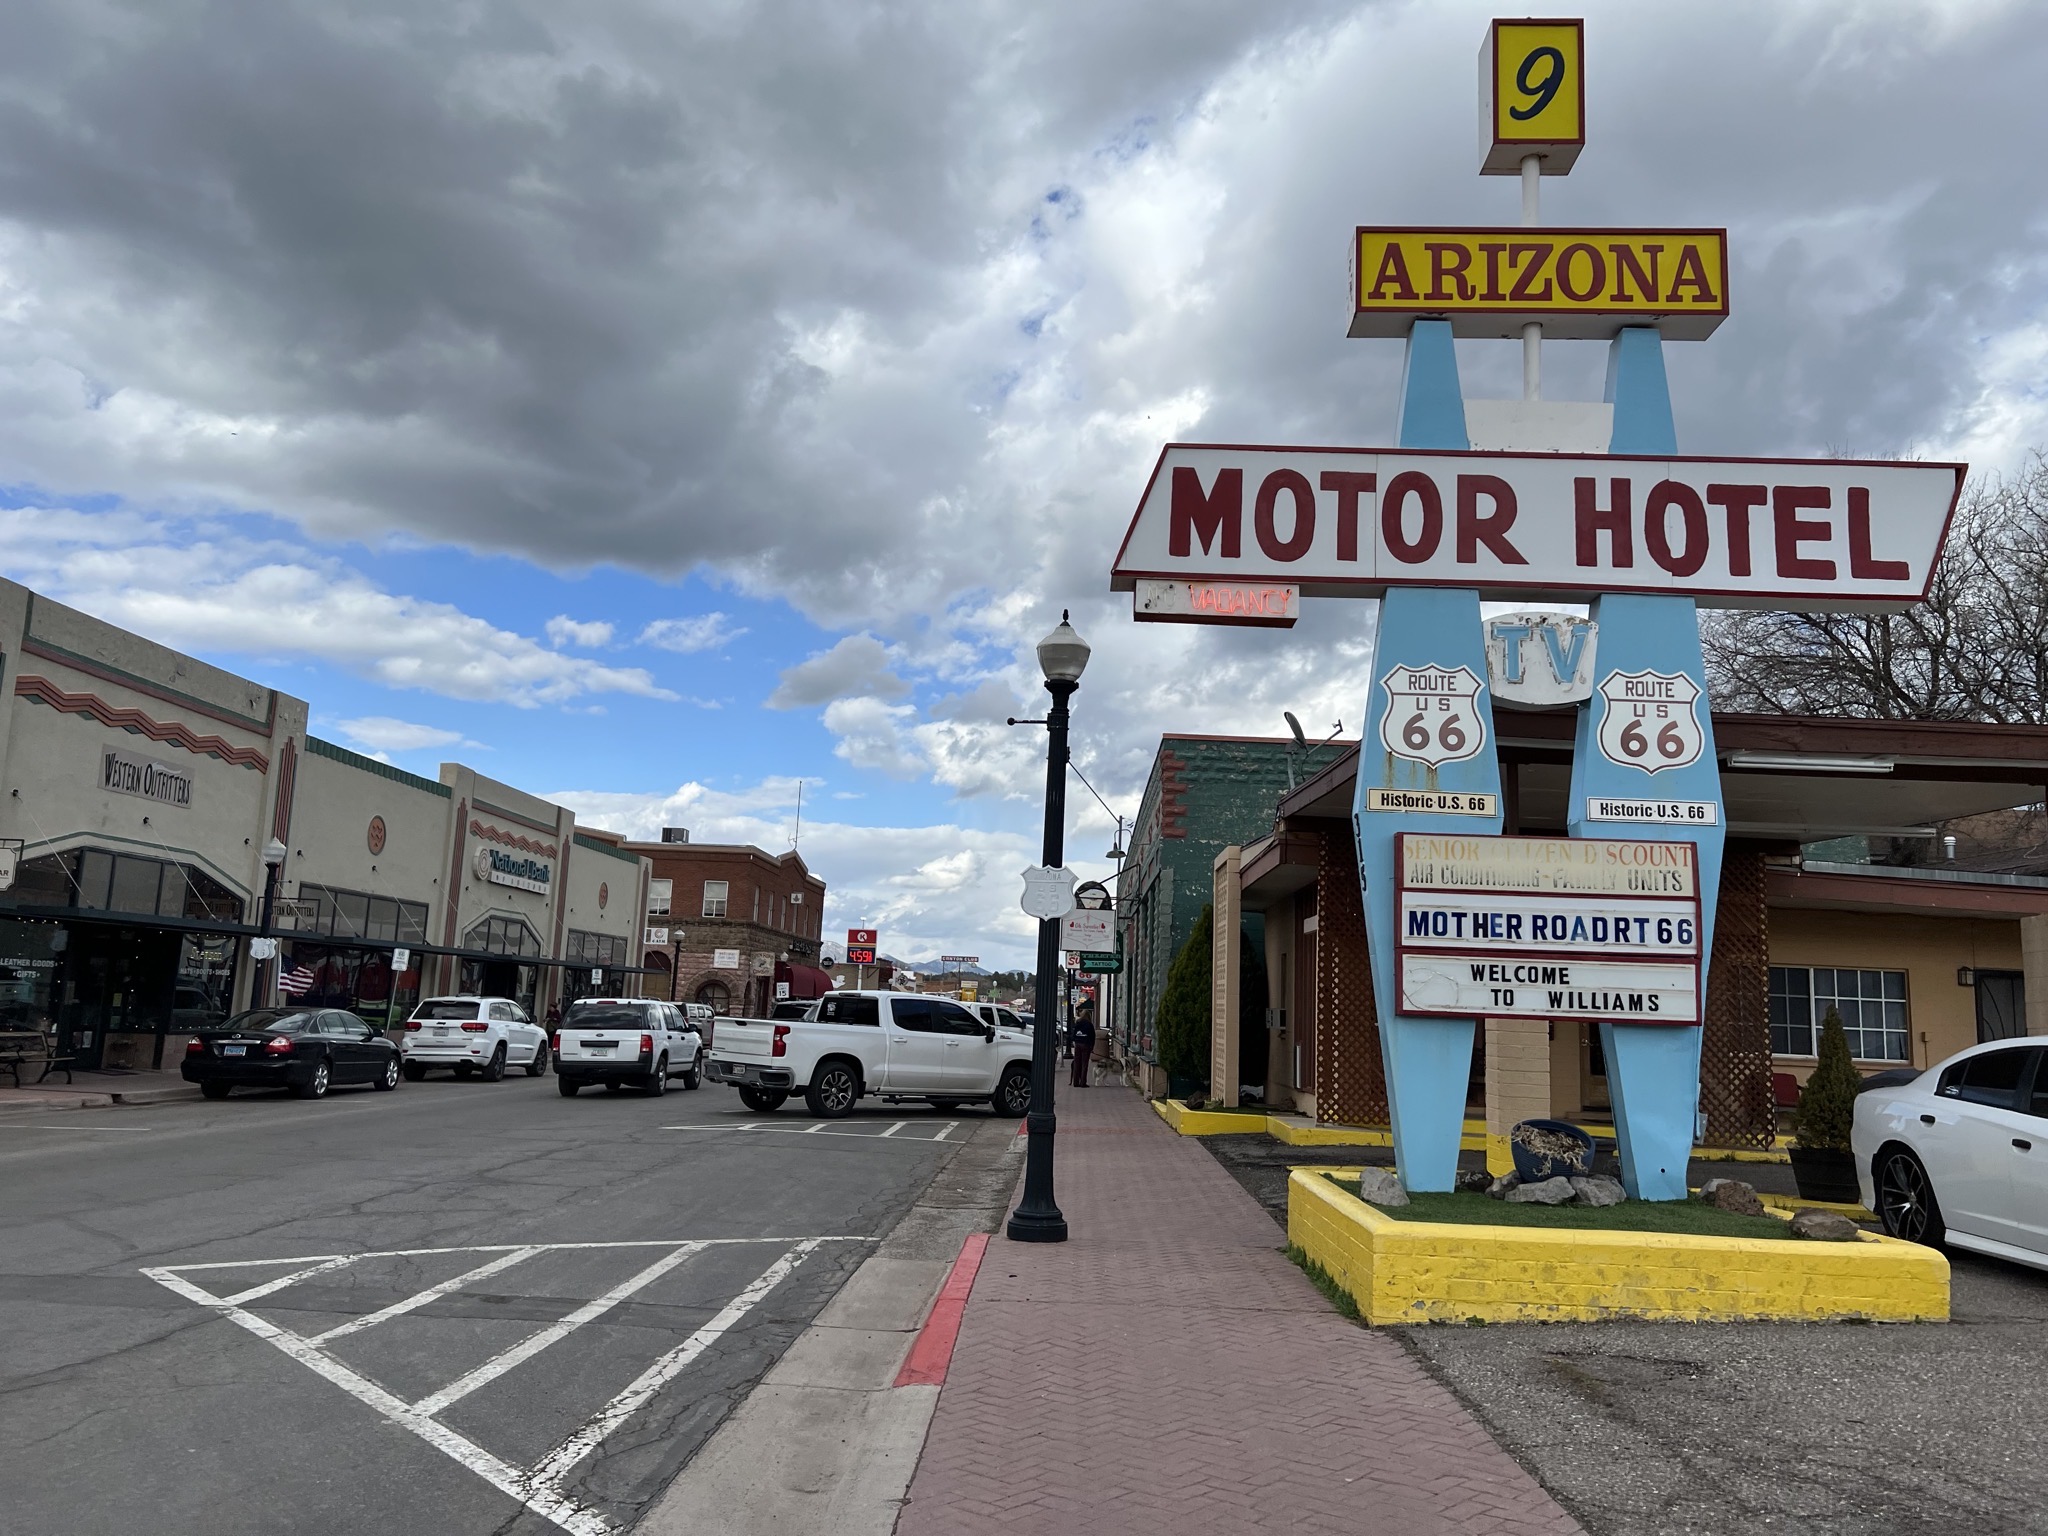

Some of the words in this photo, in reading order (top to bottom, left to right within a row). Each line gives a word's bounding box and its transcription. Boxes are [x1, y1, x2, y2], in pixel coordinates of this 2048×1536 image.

[1509, 46, 1565, 121] 9
[1368, 242, 1718, 303] ARIZONA
[1168, 468, 1530, 566] MOTOR
[1574, 476, 1910, 581] HOTEL
[1188, 584, 1292, 615] VACANCY
[1491, 622, 1591, 685] TV
[1408, 675, 1457, 692] ROUTE
[1625, 680, 1675, 698] ROUTE
[1402, 712, 1466, 751] 66
[1620, 719, 1685, 759] 66
[105, 753, 142, 793] WESTERN
[144, 763, 191, 805] OUTFITTERS
[1381, 793, 1433, 810] Historic
[1437, 796, 1464, 811] U.S.
[1468, 798, 1485, 811] 66
[1600, 802, 1653, 818] Historic
[1657, 805, 1684, 819] U.S.
[1688, 807, 1705, 820] 66
[490, 849, 528, 877] National
[530, 861, 549, 882] Bank
[1404, 840, 1480, 861] SENIOR
[1491, 841, 1572, 863] CIIZEN
[1584, 843, 1692, 867] DSCOUNT
[1410, 863, 1433, 884] AIR
[1628, 869, 1683, 892] UNITS
[1408, 911, 1523, 940] MOTHER
[1658, 918, 1693, 945] 66
[0, 958, 30, 966] LEATHER
[17, 970, 36, 978] GIFTS
[1470, 964, 1570, 985] WELCOME
[1490, 989, 1514, 1007] TO
[1548, 991, 1659, 1012] WILLIAMS
